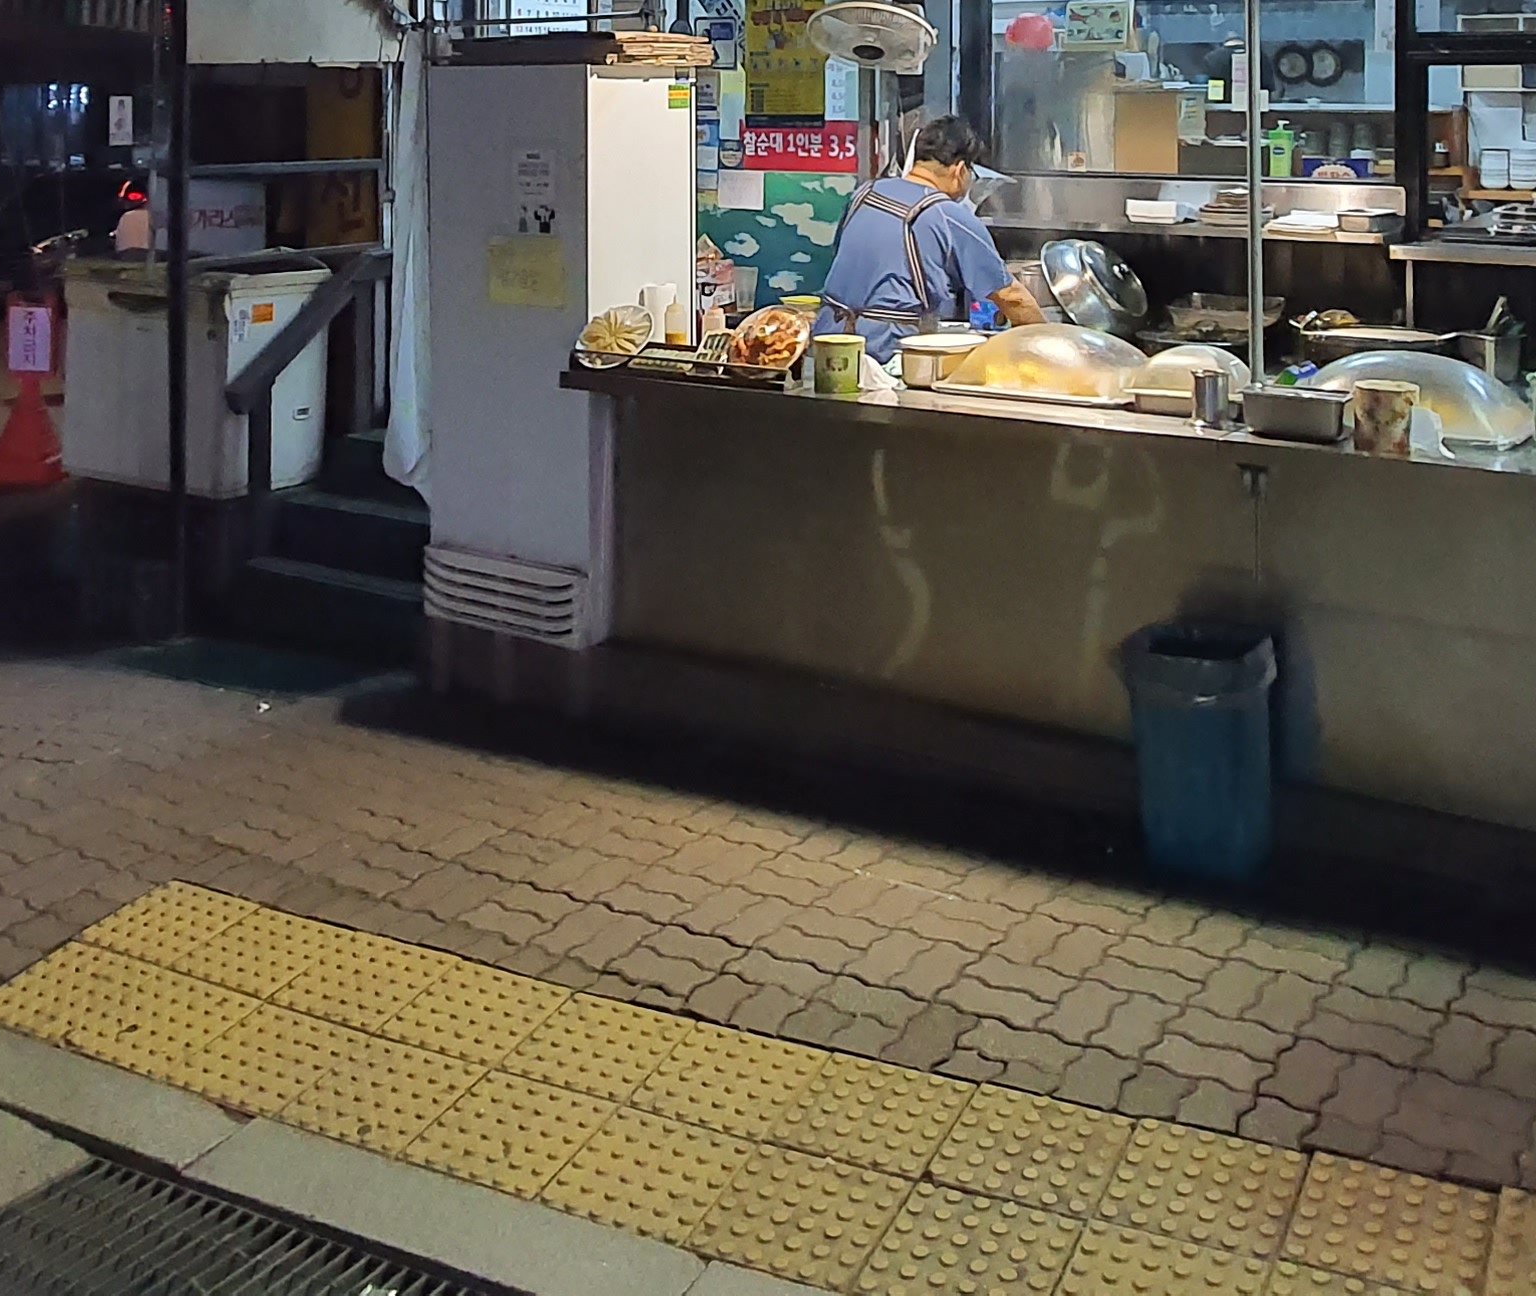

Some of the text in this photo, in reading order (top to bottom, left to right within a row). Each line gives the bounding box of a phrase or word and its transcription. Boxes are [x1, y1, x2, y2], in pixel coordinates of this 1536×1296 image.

[743, 131, 784, 157] 찰순대
[787, 134, 824, 158] 1인분
[828, 135, 856, 161] 3,5
